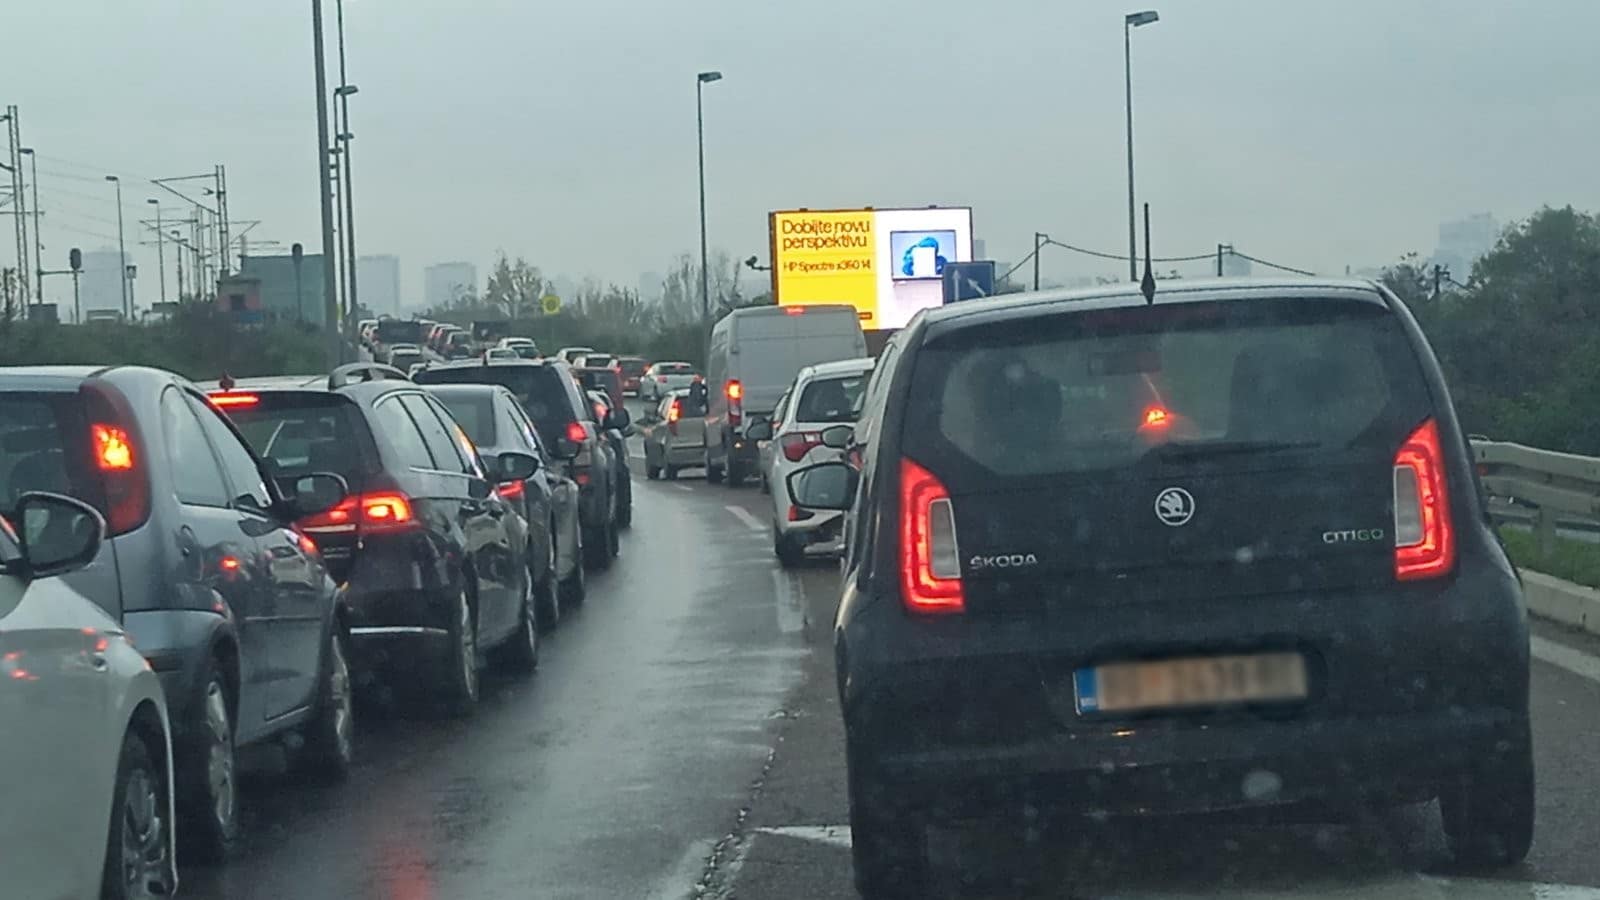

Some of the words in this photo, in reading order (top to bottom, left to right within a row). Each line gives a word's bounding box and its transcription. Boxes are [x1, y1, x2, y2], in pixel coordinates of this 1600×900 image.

[782, 219, 832, 235] Dobijte
[834, 220, 870, 233] novu
[783, 234, 867, 251] perspektivu
[783, 261, 797, 271] HP
[798, 261, 835, 272] Spectre
[1323, 528, 1384, 543] CITIGO
